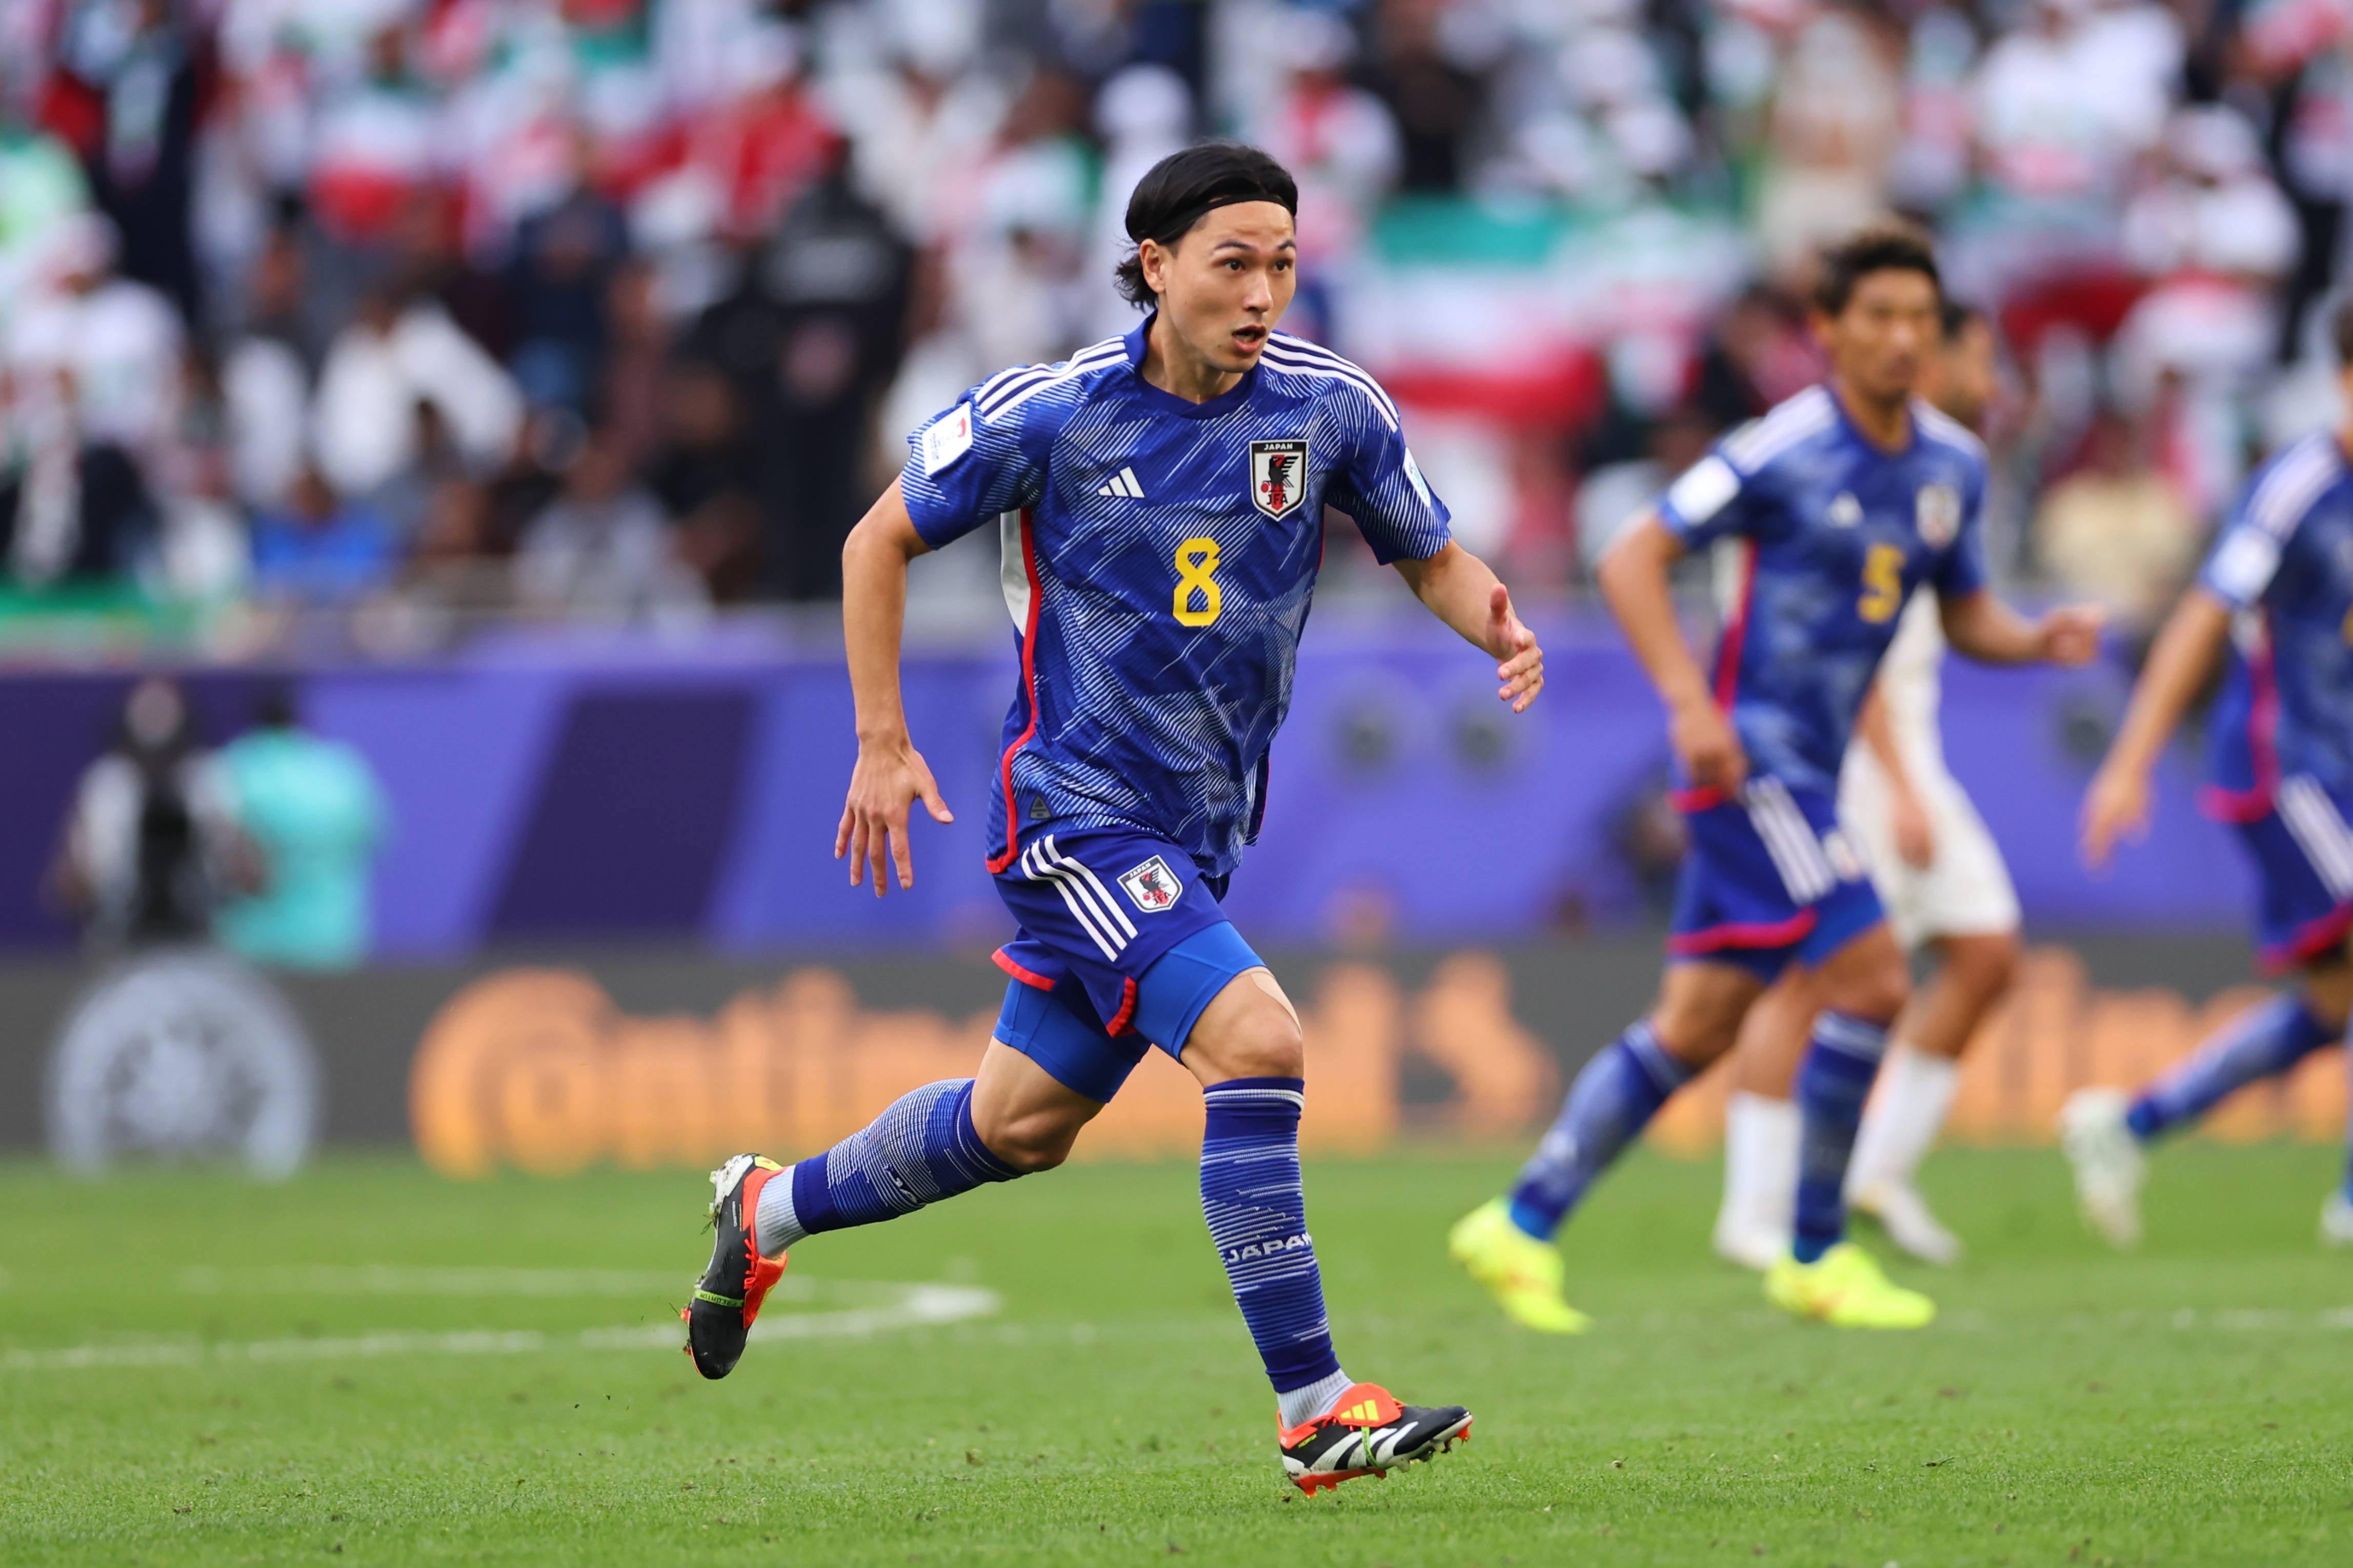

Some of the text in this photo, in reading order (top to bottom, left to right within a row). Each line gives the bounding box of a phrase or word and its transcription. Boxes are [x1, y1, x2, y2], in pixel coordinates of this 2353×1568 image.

[1266, 493, 1289, 505] JFA
[1173, 537, 1221, 627] 8
[1857, 541, 1906, 625] 5
[1129, 862, 1152, 878] JAPAN
[1227, 1232, 1313, 1263] JAPAN
